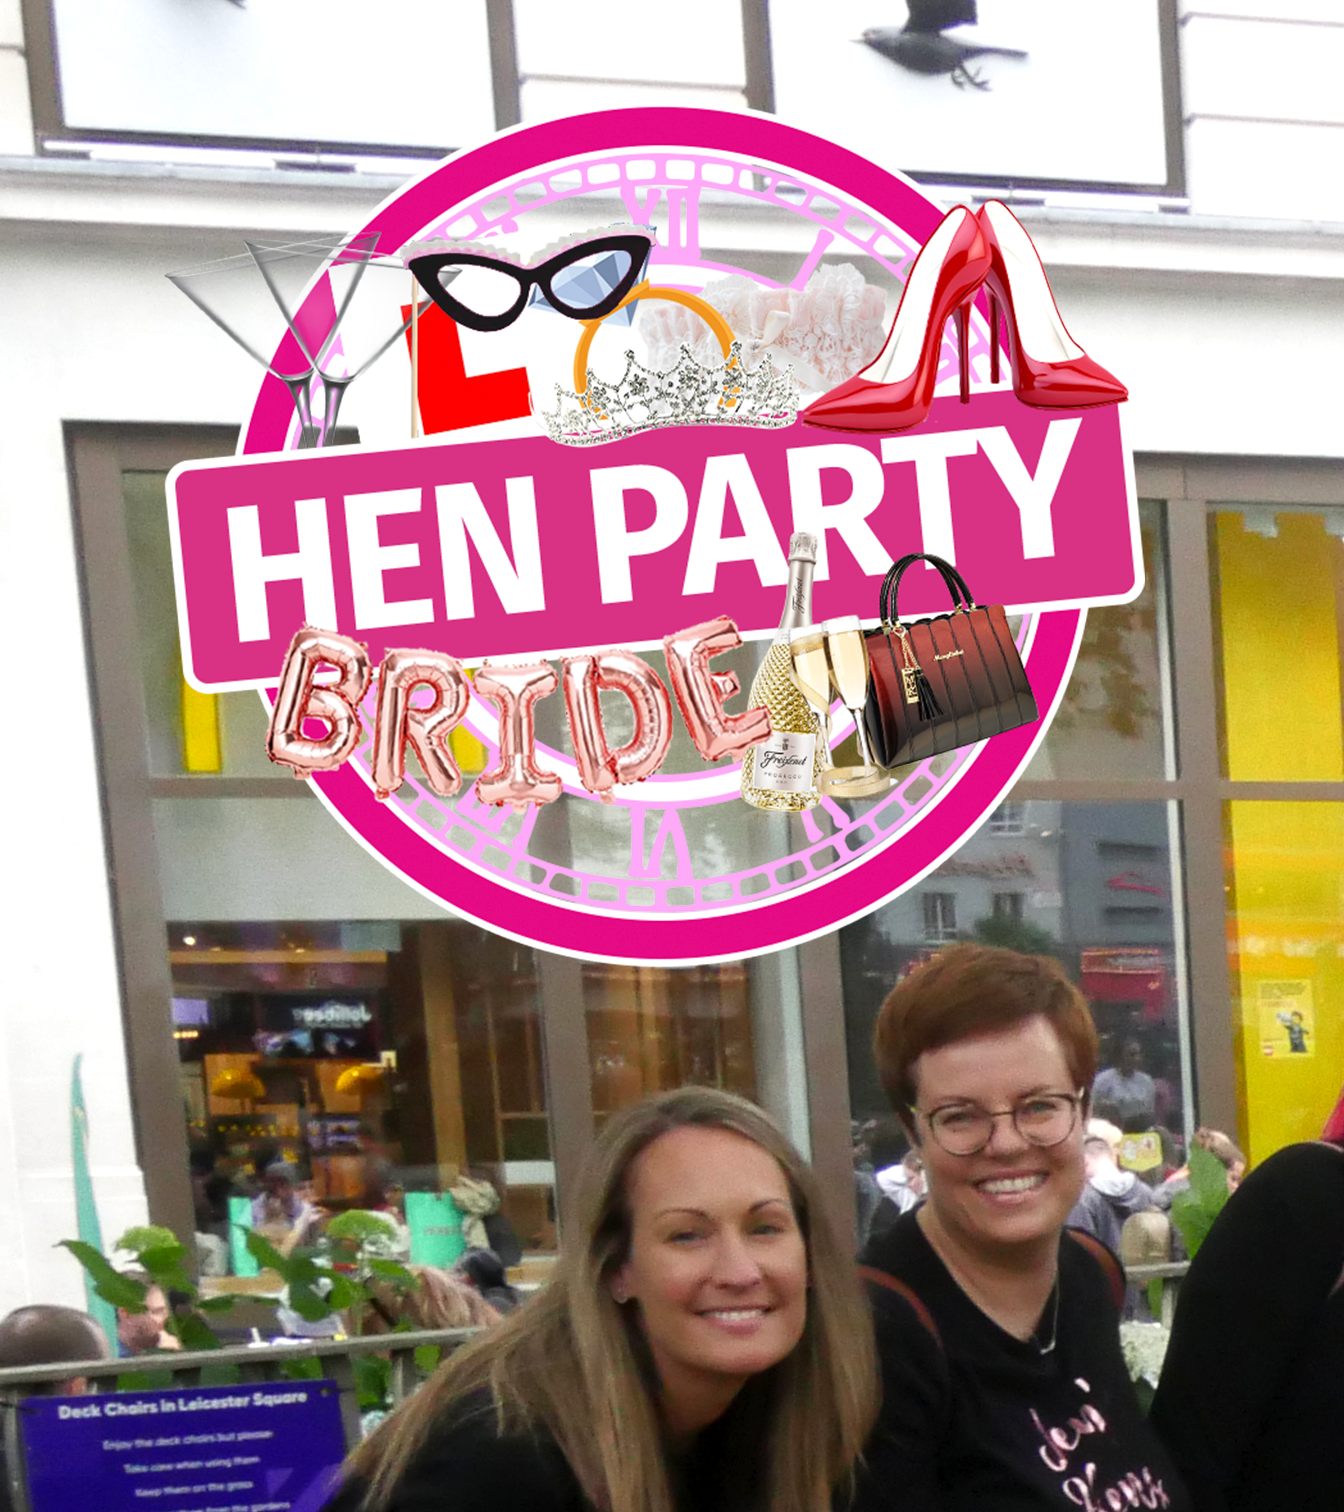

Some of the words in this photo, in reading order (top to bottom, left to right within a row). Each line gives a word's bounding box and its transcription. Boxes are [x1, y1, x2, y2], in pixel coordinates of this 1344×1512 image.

[58, 1403, 102, 1420] Deck
[103, 1400, 158, 1416] Chairs
[160, 1398, 176, 1413] in
[178, 1396, 250, 1412] Leicester
[252, 1391, 308, 1408] Square
